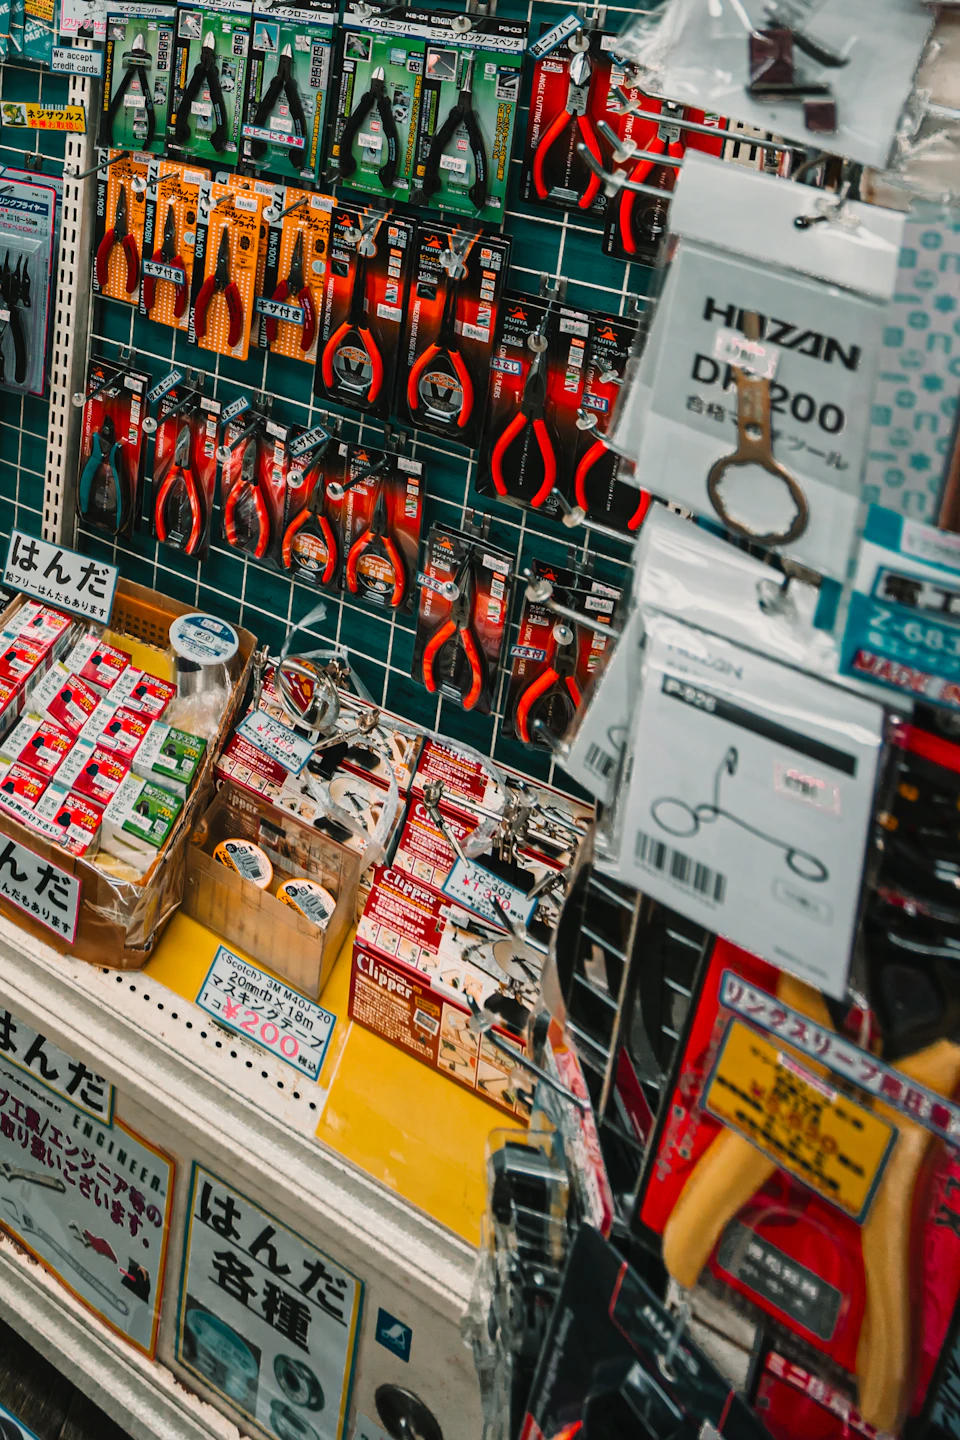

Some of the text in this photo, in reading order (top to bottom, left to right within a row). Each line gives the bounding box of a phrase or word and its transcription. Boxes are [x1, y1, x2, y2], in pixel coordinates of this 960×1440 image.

[52, 49, 93, 63] We accept
[52, 60, 100, 75] credit cards.
[27, 110, 83, 122] ネジザウルス
[30, 119, 84, 131] 各種お取扱い
[144, 261, 183, 285] ギザ付き
[258, 299, 303, 322] ギザ付き
[11, 535, 111, 601] はんだ
[4, 571, 108, 617] 鉛フリーはんだもあります
[382, 868, 437, 905] Clipper
[473, 871, 512, 900] TC-303
[356, 953, 414, 998] Clipper
[378, 965, 413, 990] TOOL
[212, 974, 325, 1050] マスキングテープ
[267, 978, 283, 993] 3M
[285, 989, 333, 1026] M40J-20
[221, 997, 300, 1060] ¥200
[297, 1052, 318, 1074] 税込
[200, 1180, 347, 1319] はんだ
[213, 1250, 311, 1350] 各種
